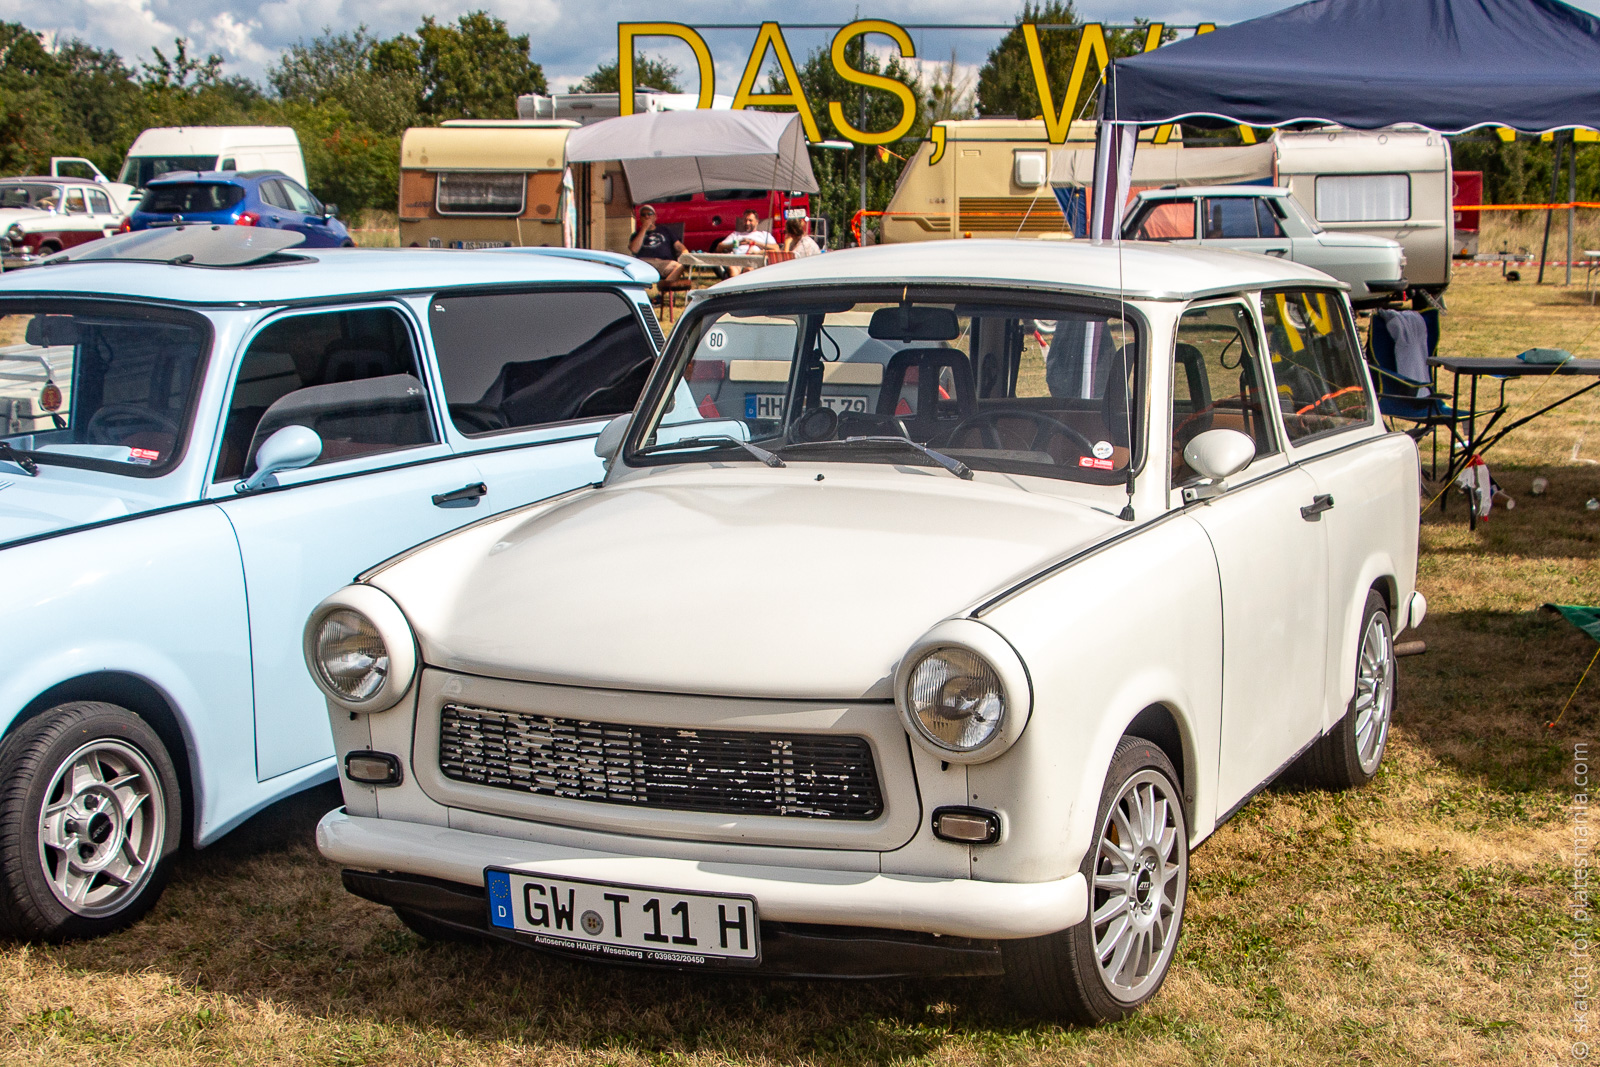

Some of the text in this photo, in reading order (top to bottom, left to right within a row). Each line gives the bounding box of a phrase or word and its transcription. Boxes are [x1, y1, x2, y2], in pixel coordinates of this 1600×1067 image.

[710, 333, 723, 347] 80
[757, 396, 783, 417] HH
[498, 882, 749, 950] D GW T 11 H
[534, 935, 705, 964] Autoservice HAUFF Wesenberg 039832/20450
